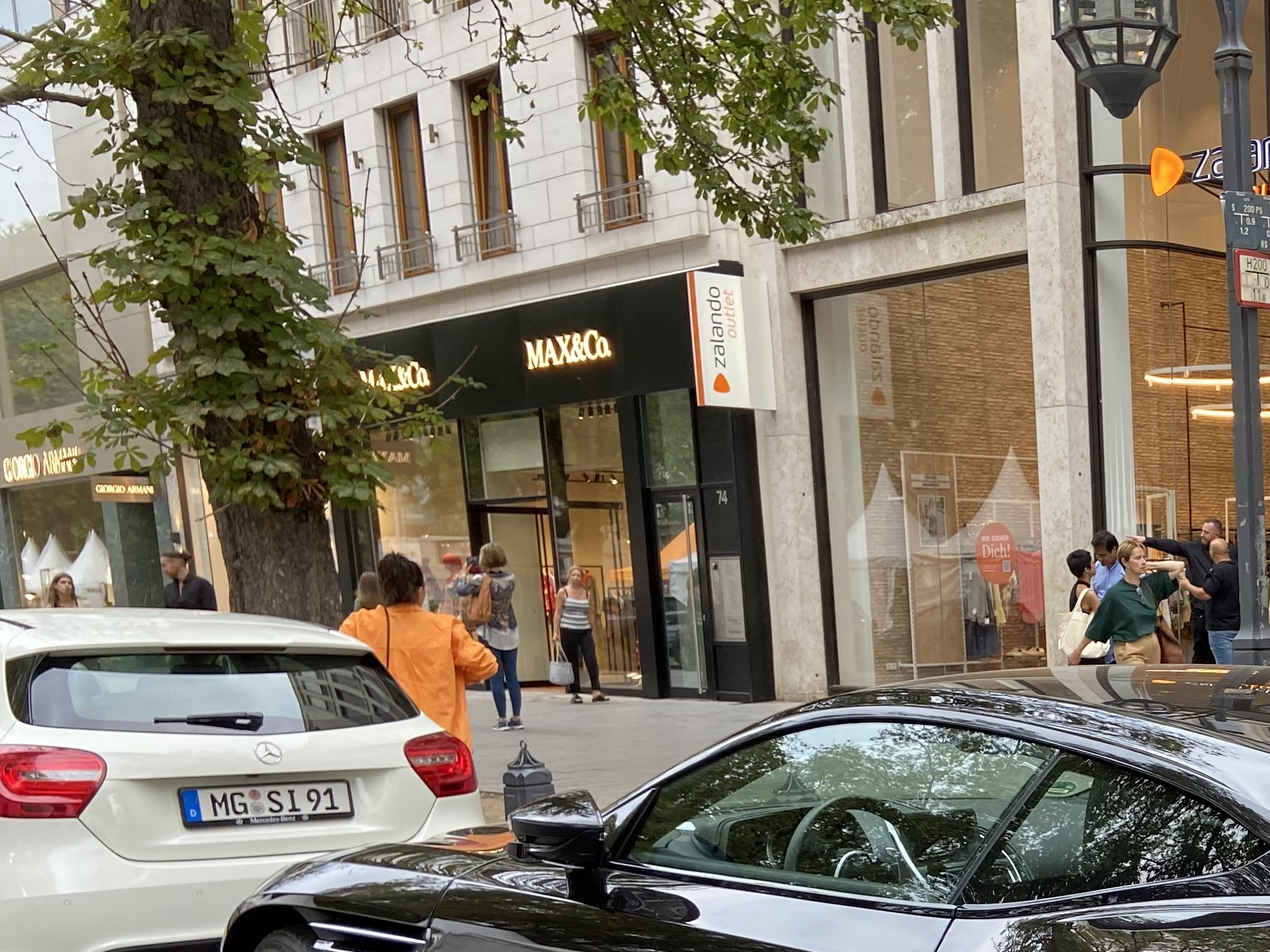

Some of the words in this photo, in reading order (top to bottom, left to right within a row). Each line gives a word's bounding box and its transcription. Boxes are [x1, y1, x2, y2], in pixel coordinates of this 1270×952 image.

[706, 285, 727, 369] zalando
[722, 288, 737, 339] outlet
[524, 329, 612, 370] MAX&Co.
[3, 453, 40, 483] GIORGIO
[95, 484, 126, 494] GIORGIO
[126, 485, 155, 495] ARMANI
[716, 490, 728, 505] 74
[982, 542, 1011, 558] Dich!
[209, 791, 249, 817] MG
[306, 787, 339, 811] 91
[250, 815, 296, 824] Mercedes-Benz
